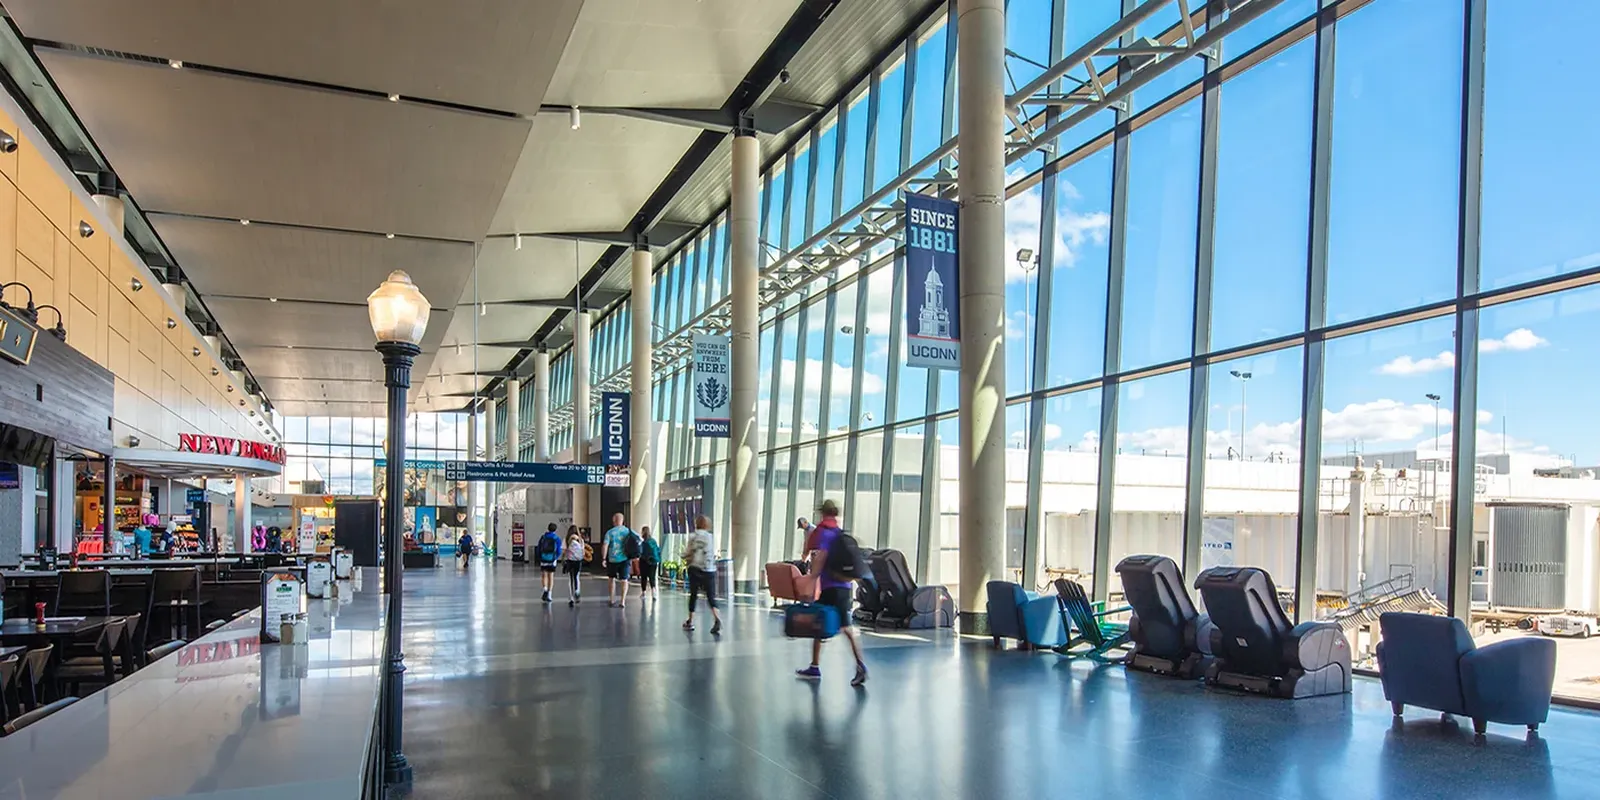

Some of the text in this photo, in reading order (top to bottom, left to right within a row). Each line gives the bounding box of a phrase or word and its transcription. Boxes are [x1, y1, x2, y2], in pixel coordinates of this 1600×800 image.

[910, 207, 955, 230] SINCE
[910, 226, 956, 254] 1881
[696, 349, 726, 357] ANYWHERE
[702, 355, 720, 363] FROM
[911, 345, 957, 360] UCONN
[697, 362, 727, 374] HERE
[609, 397, 623, 461] UCONN
[697, 423, 728, 432] UCONN
[178, 433, 286, 466] NEW ENGLAN
